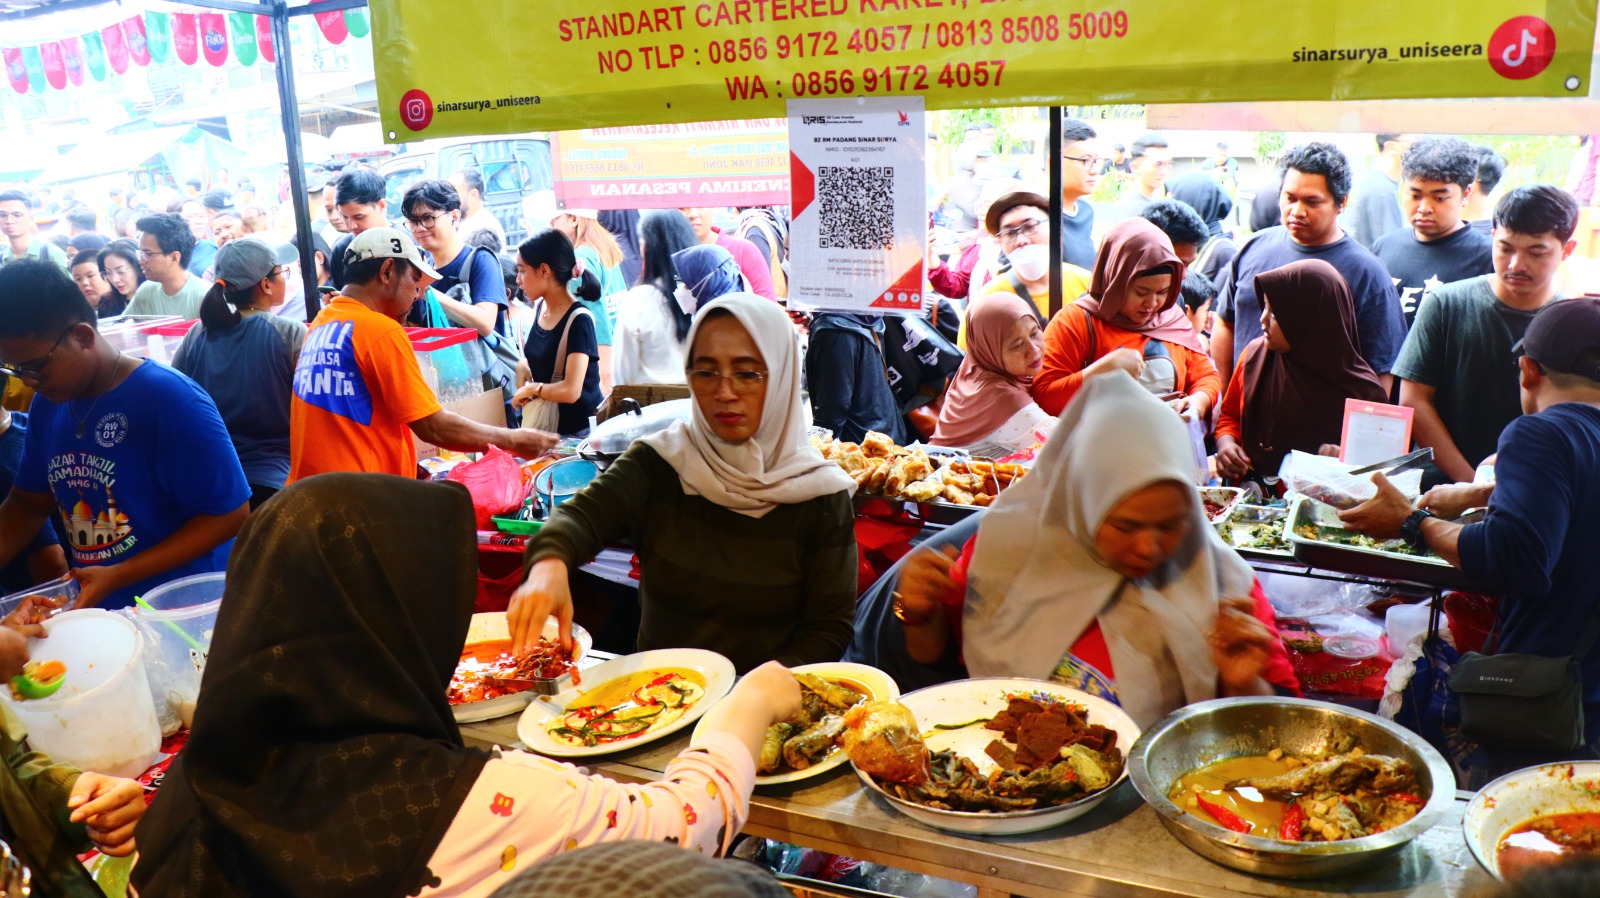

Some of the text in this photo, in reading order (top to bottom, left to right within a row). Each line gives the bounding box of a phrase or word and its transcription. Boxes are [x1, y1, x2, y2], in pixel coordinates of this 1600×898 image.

[558, 6, 686, 42] STANDART
[695, 0, 848, 28] CARTERED
[205, 33, 226, 45] FANTA
[598, 49, 633, 74] NO
[638, 44, 685, 70] TLP
[708, 36, 768, 64] 0856
[776, 31, 839, 59] 9172
[847, 25, 913, 54] 4057
[921, 23, 930, 49] /
[937, 19, 993, 48] 0813
[1001, 14, 1059, 44] 8508
[1068, 10, 1128, 40] 5009
[1292, 42, 1483, 64] sinarsurya_uniseera
[725, 75, 769, 101] WA
[792, 68, 855, 97] 0856
[862, 64, 929, 93] 9172
[937, 59, 1007, 88] 4057
[437, 95, 541, 113] sinarsurya_uniseera
[390, 238, 403, 254] 3
[298, 367, 356, 397] FANTA
[103, 421, 118, 431] RW
[103, 430, 116, 439] 01
[80, 453, 116, 475] TAKJIL
[48, 466, 116, 488] RAMADHAN
[66, 479, 91, 489] 1446
